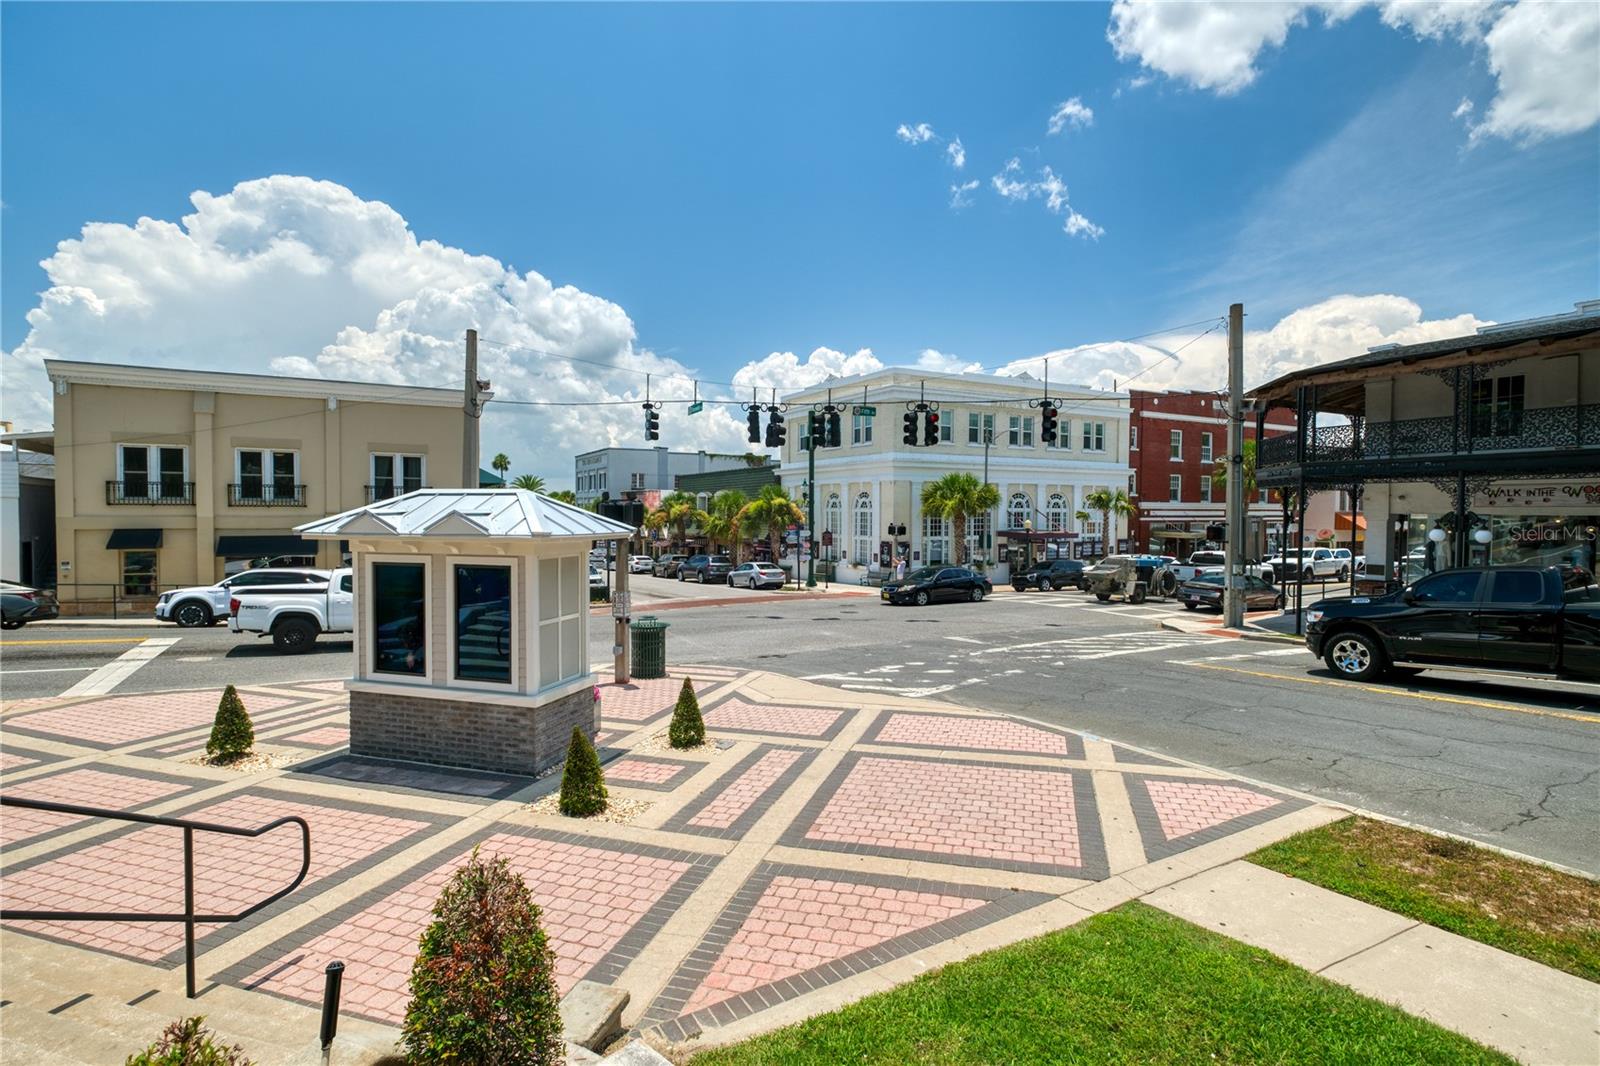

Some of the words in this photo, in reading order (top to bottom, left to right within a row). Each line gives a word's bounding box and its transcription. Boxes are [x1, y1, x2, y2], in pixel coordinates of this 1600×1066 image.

[1482, 486, 1521, 498] WALK
[1526, 488, 1536, 497] IN
[1536, 487, 1557, 497] THE
